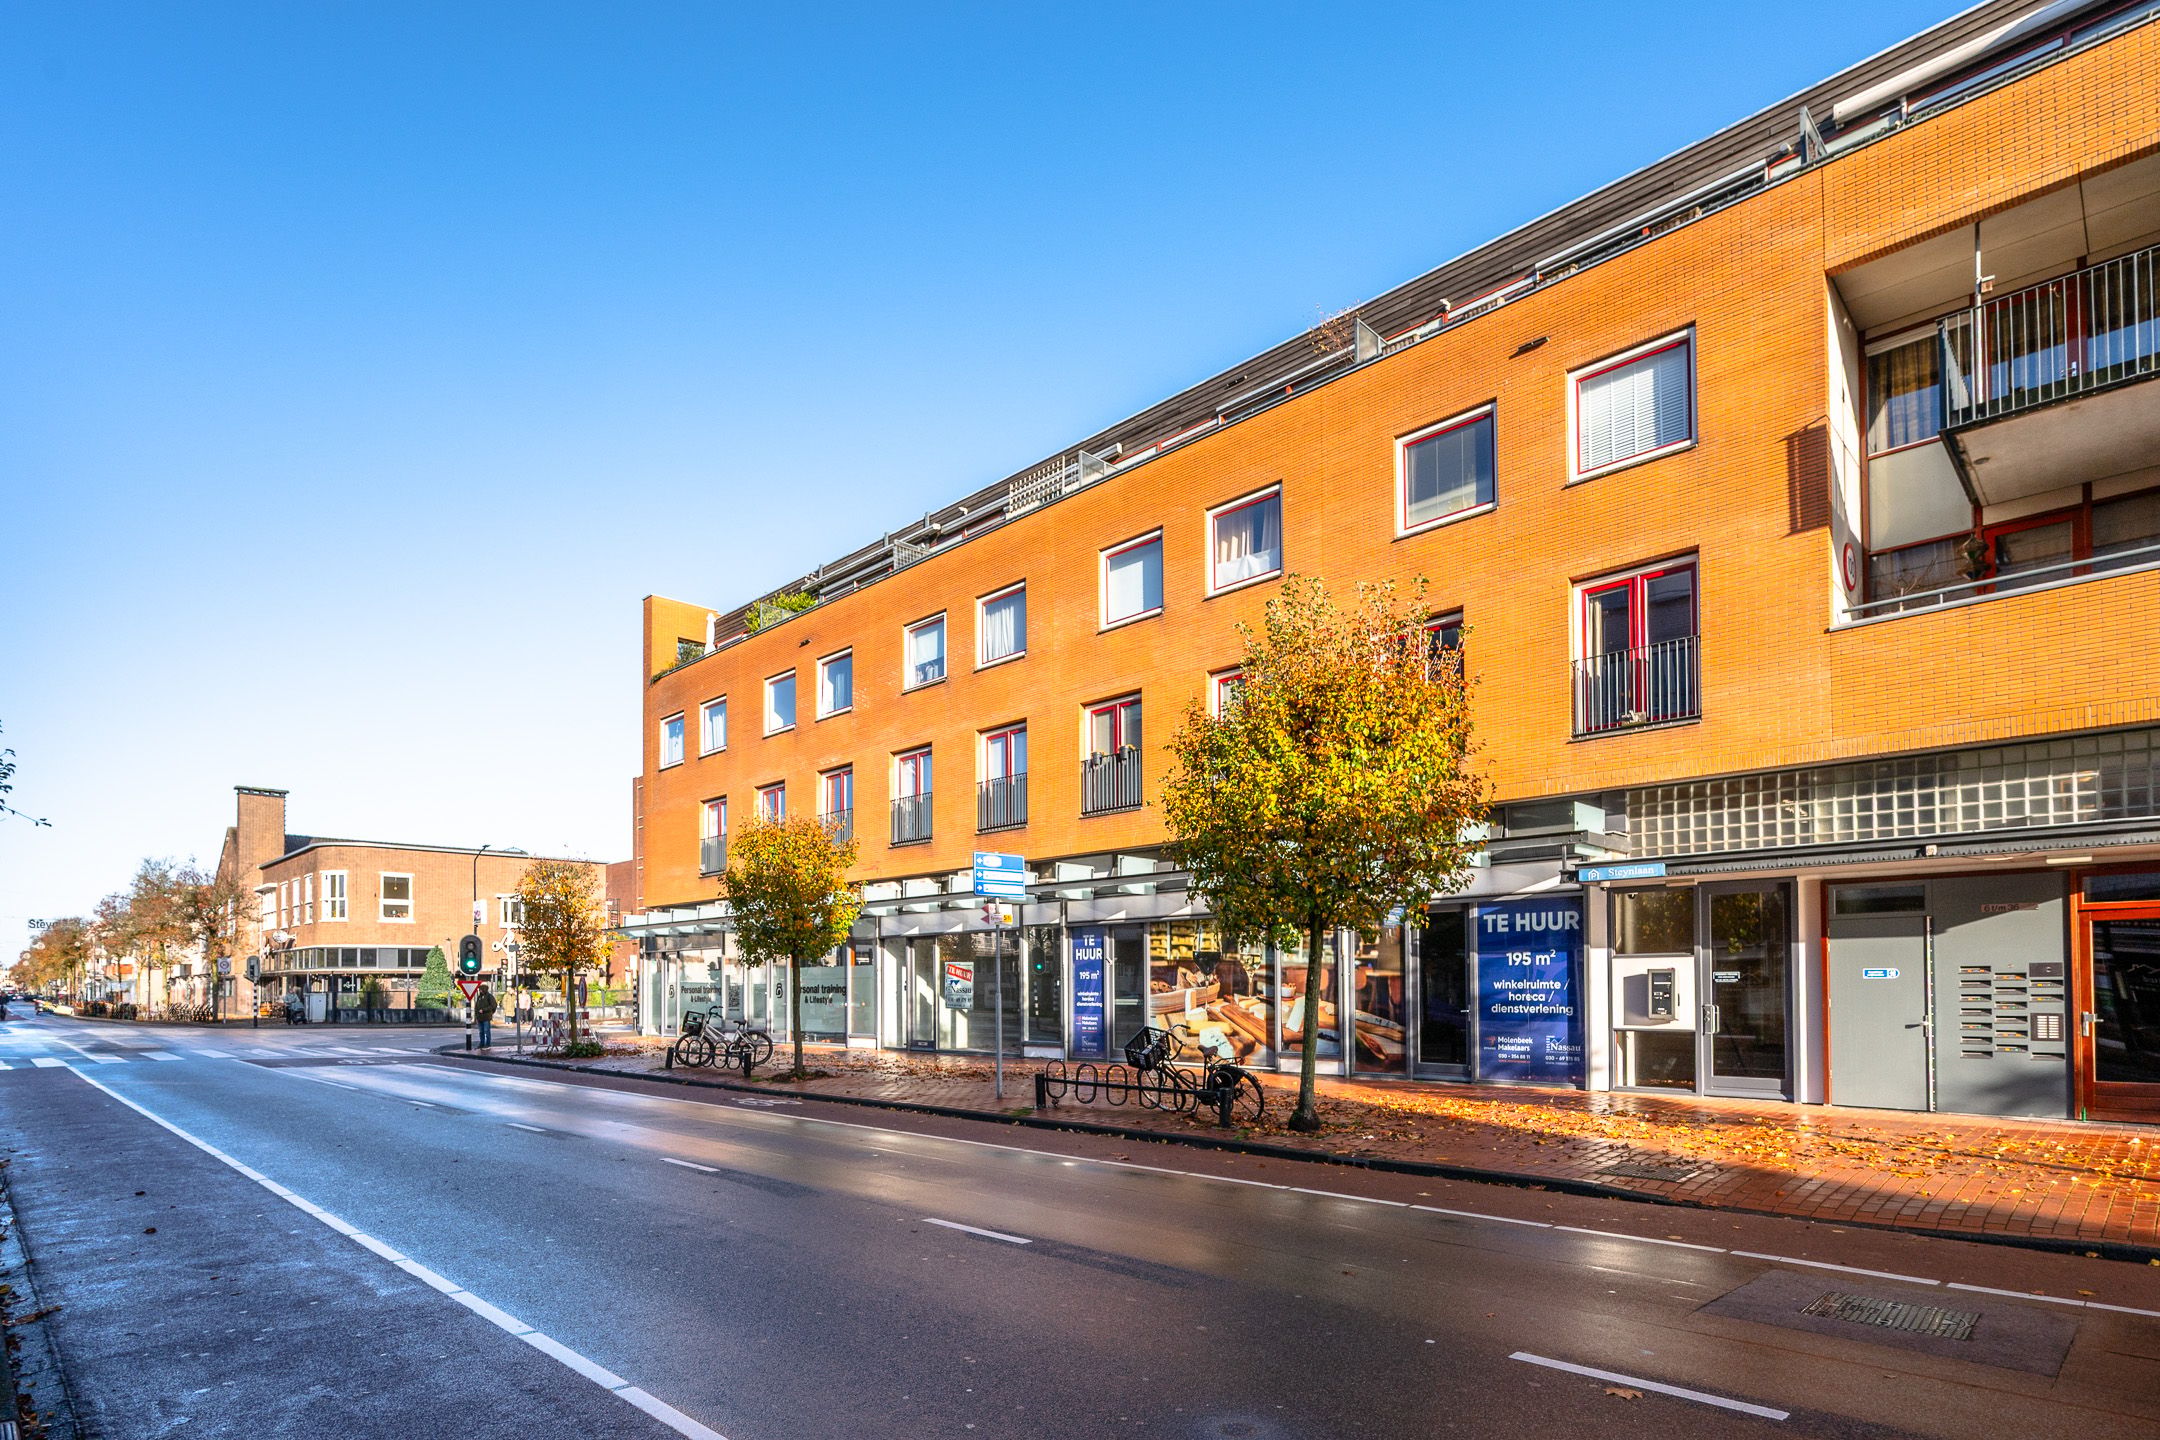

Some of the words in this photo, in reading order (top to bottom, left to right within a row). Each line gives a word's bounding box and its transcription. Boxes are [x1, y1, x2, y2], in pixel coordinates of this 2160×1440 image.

[1608, 866, 1655, 878] Steynlaan
[2007, 903, 2019, 911] 36
[1483, 913, 1509, 933] TE
[1515, 911, 1579, 932] HUUR
[1083, 934, 1095, 946] TE
[1075, 948, 1102, 960] HUUR
[1506, 952, 1532, 966] 195
[681, 985, 702, 994] Personal
[800, 984, 820, 994] rsonal
[821, 984, 847, 996] training
[1493, 979, 1562, 990] winkelruimte
[1508, 991, 1546, 1001] horeca
[1491, 1003, 1574, 1016] dienstverlening
[1497, 1036, 1533, 1044] Molenbeek
[1497, 1044, 1531, 1052] Makelaars
[1550, 1043, 1581, 1052] Nassau
